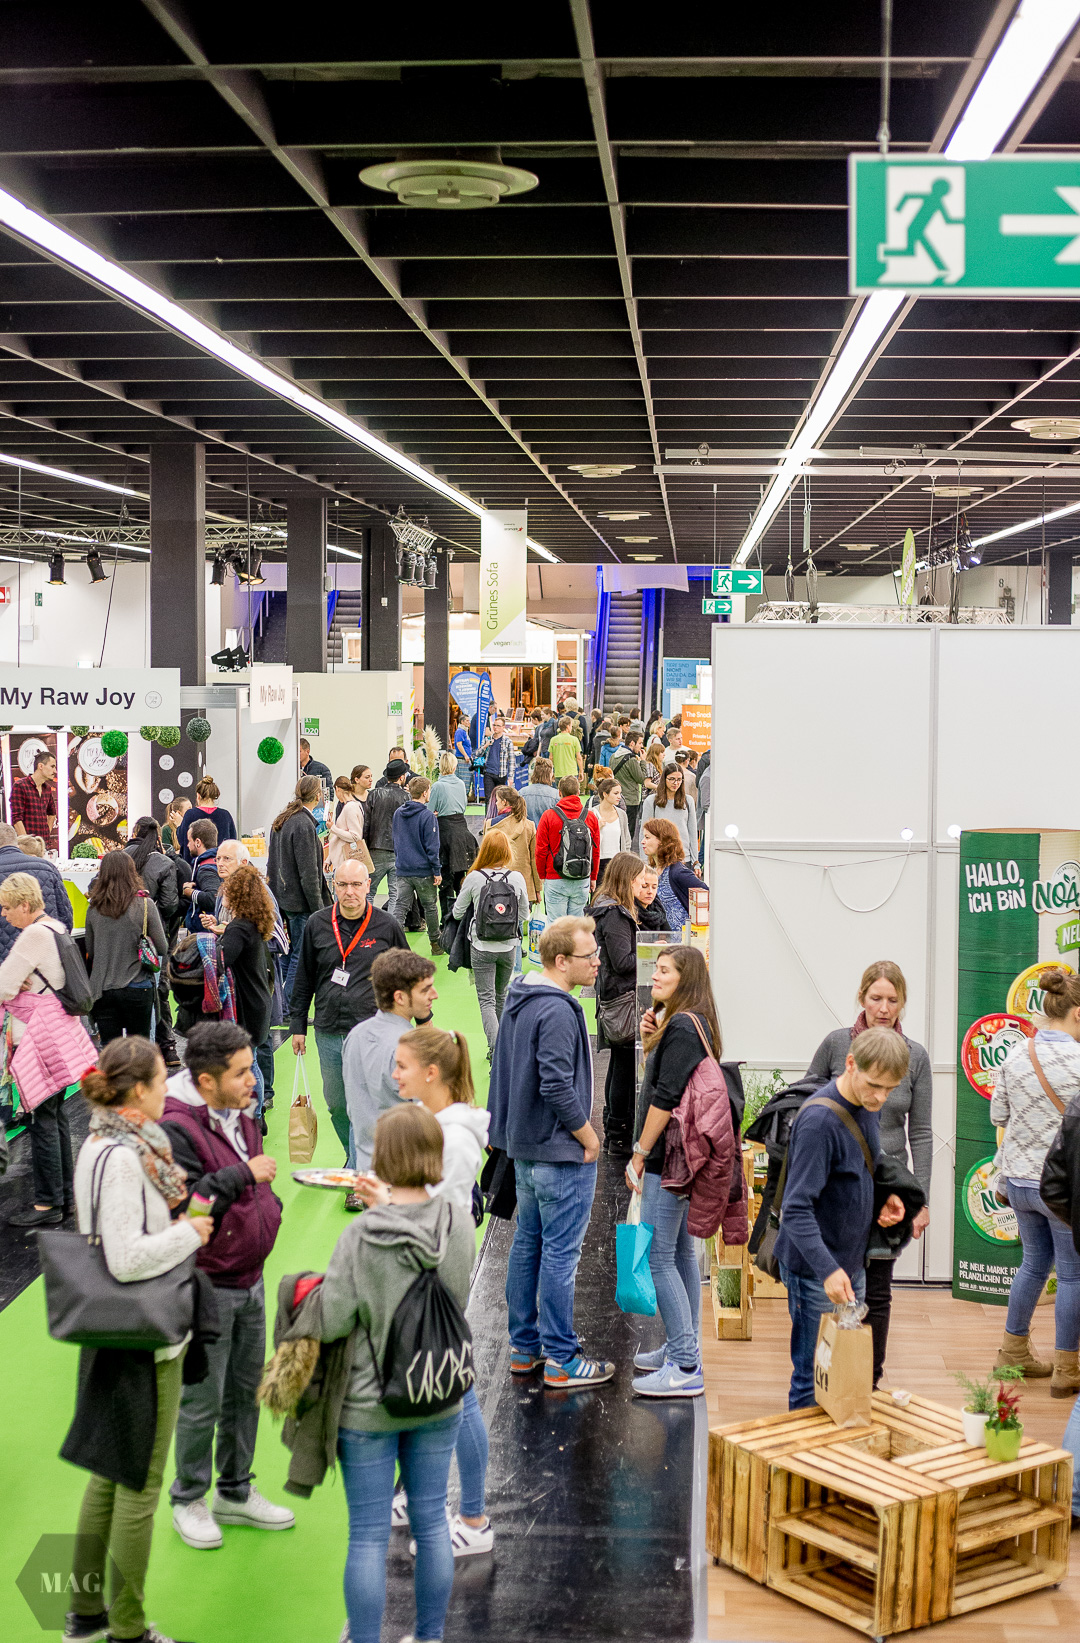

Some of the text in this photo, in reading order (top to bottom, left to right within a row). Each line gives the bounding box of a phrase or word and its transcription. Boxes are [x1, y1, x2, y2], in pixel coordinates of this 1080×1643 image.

[487, 562, 499, 630] Grünes Sofa
[0, 688, 32, 710] My
[40, 688, 89, 706] Raw
[95, 688, 136, 710] Joy
[260, 685, 267, 706] My
[268, 685, 278, 702] Raw
[965, 860, 1025, 888] HALLO,
[980, 1045, 1007, 1068] NO
[997, 1213, 1016, 1224] HUMM
[959, 1260, 1019, 1276] DIE NEUE MARKE FÜ
[959, 1270, 1014, 1285] PFLANZLICHEN GEN
